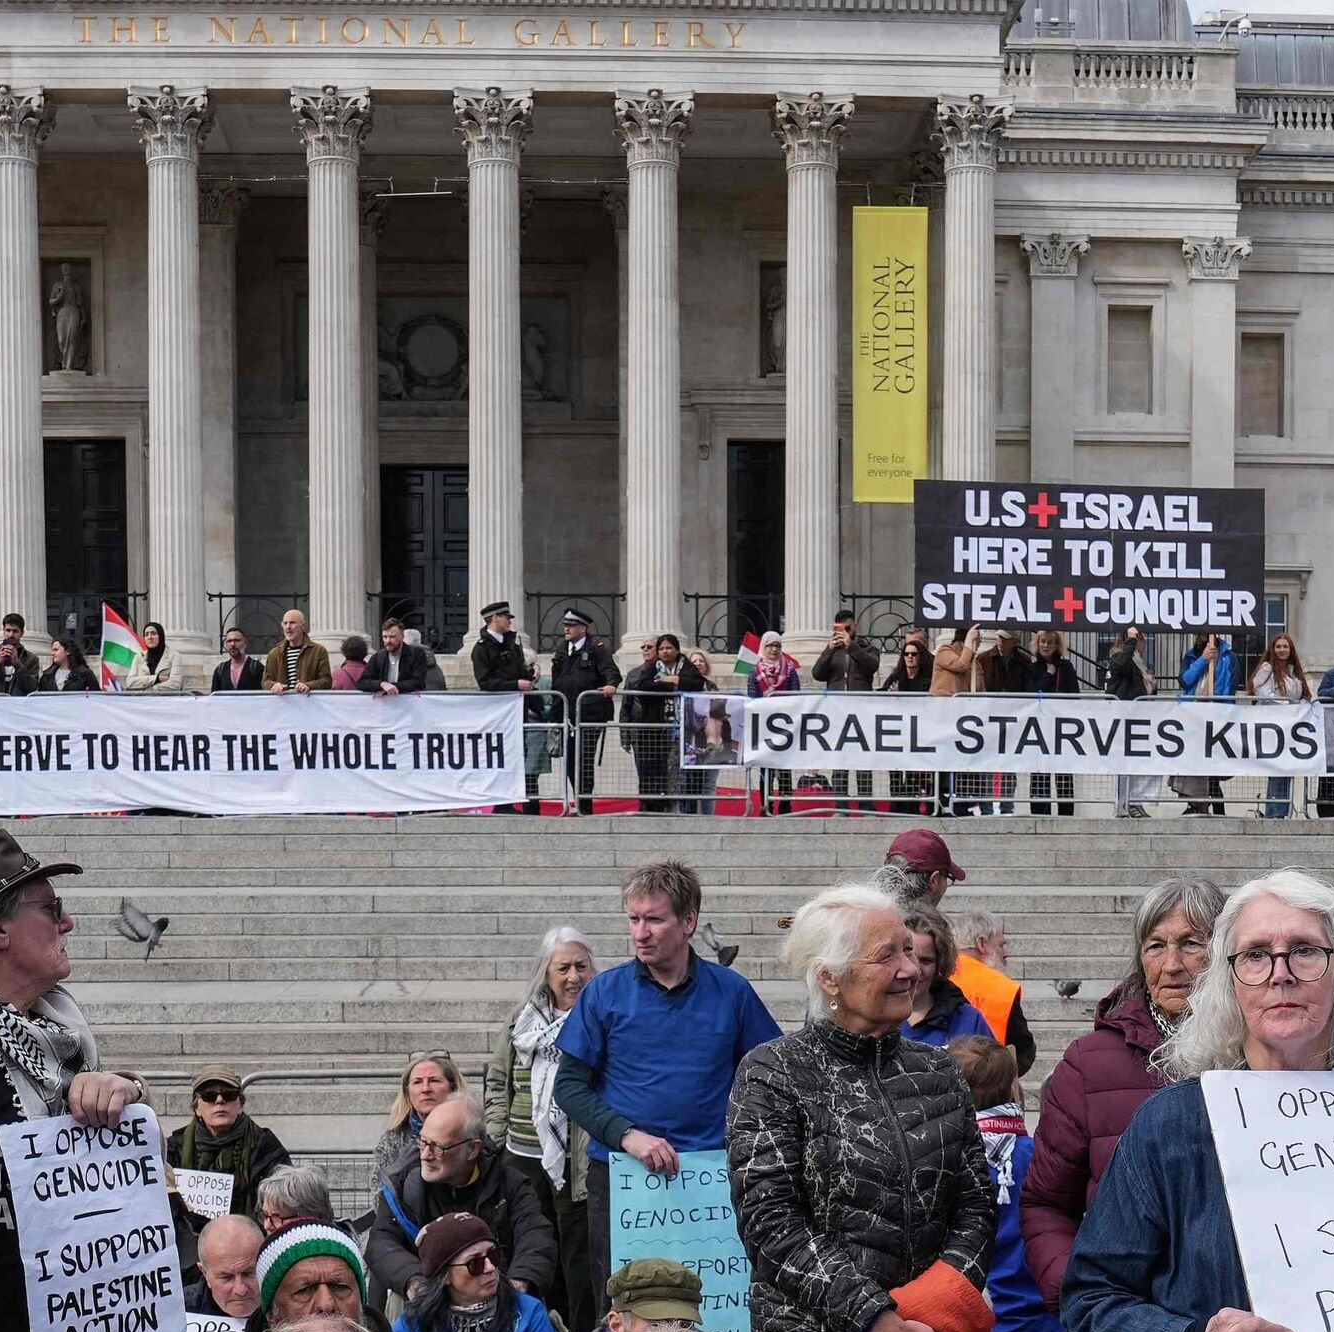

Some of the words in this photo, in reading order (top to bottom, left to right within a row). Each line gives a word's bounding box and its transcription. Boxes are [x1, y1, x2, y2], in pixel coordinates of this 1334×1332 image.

[72, 16, 172, 43] THE
[207, 17, 476, 45] NATIONAL
[513, 19, 748, 48] GALLERY
[860, 331, 870, 359] THE
[872, 256, 891, 393] NATIONAL
[894, 258, 916, 394] GALLERY
[867, 453, 888, 464] Free
[891, 453, 906, 464] for
[867, 468, 913, 480] everyone
[953, 537, 1052, 575] HERE
[1064, 540, 1113, 577] TO
[1125, 542, 1226, 579] KILL
[82, 733, 118, 770] TO
[132, 734, 210, 772] HEAR
[222, 734, 279, 771] THE
[290, 733, 396, 770] WHOLE
[408, 732, 504, 770] TRUTH
[751, 713, 936, 752] ISRAEL
[955, 715, 1185, 757] STARVES
[1205, 721, 1317, 760] KIDS
[1234, 1087, 1247, 1128] I
[21, 1134, 42, 1159] I
[56, 1118, 147, 1154] OPPOSE
[33, 1155, 158, 1201] GENOCIDE
[188, 1175, 231, 1190] OPPOSE
[619, 1174, 633, 1190] I
[620, 1206, 732, 1229] GENOCID
[35, 1250, 54, 1282] I
[60, 1225, 169, 1277] SUPPORT
[1275, 1223, 1292, 1268] I
[47, 1266, 172, 1324] PALESTINE
